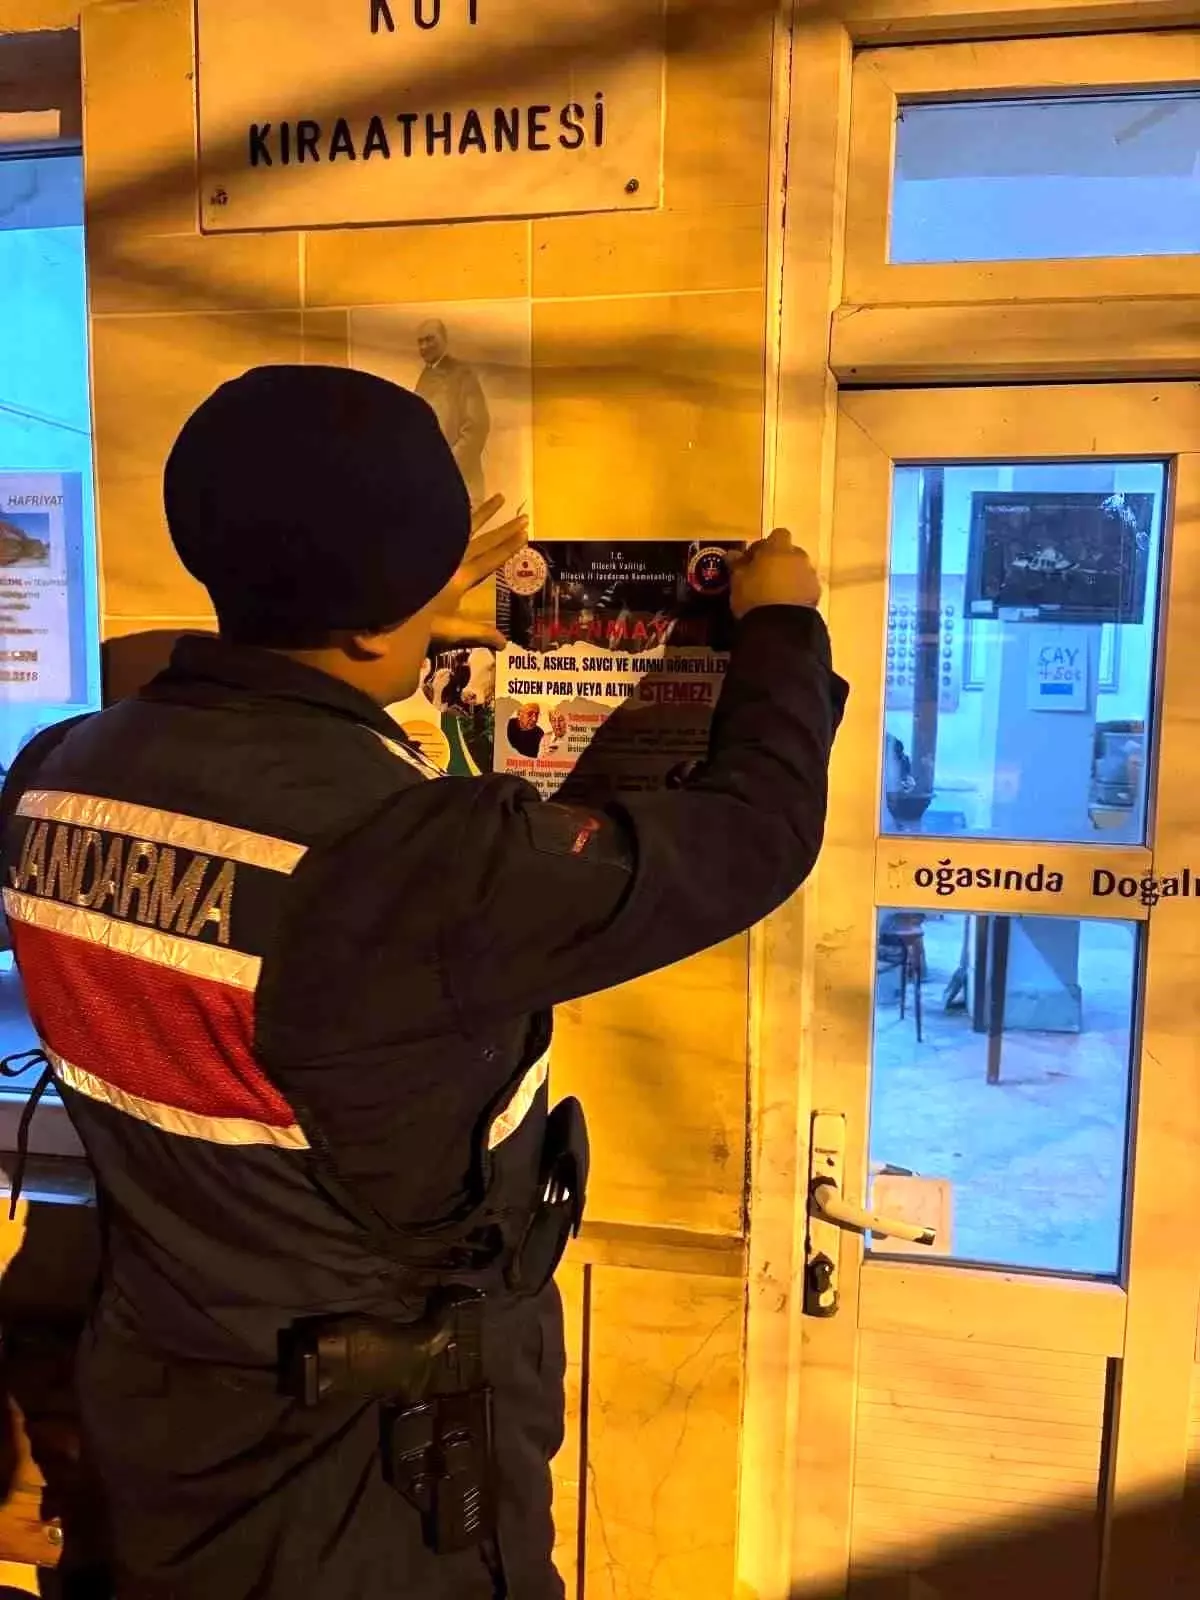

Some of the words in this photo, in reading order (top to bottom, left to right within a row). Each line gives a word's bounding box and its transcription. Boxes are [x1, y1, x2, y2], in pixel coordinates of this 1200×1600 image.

[249, 91, 605, 167] KIRAATHANESİ
[508, 653, 541, 672] POLİS,
[544, 656, 579, 672] ASKER,
[583, 657, 613, 672] SAVCI
[616, 657, 629, 672] VE
[632, 657, 664, 673] KAMU
[666, 654, 728, 674] GÖREVLİLE
[508, 677, 543, 695] SİZDEN
[547, 681, 573, 696] PARA
[577, 682, 602, 697] VEYA
[605, 682, 634, 698] ALTIN
[9, 820, 237, 945] JANDARMA
